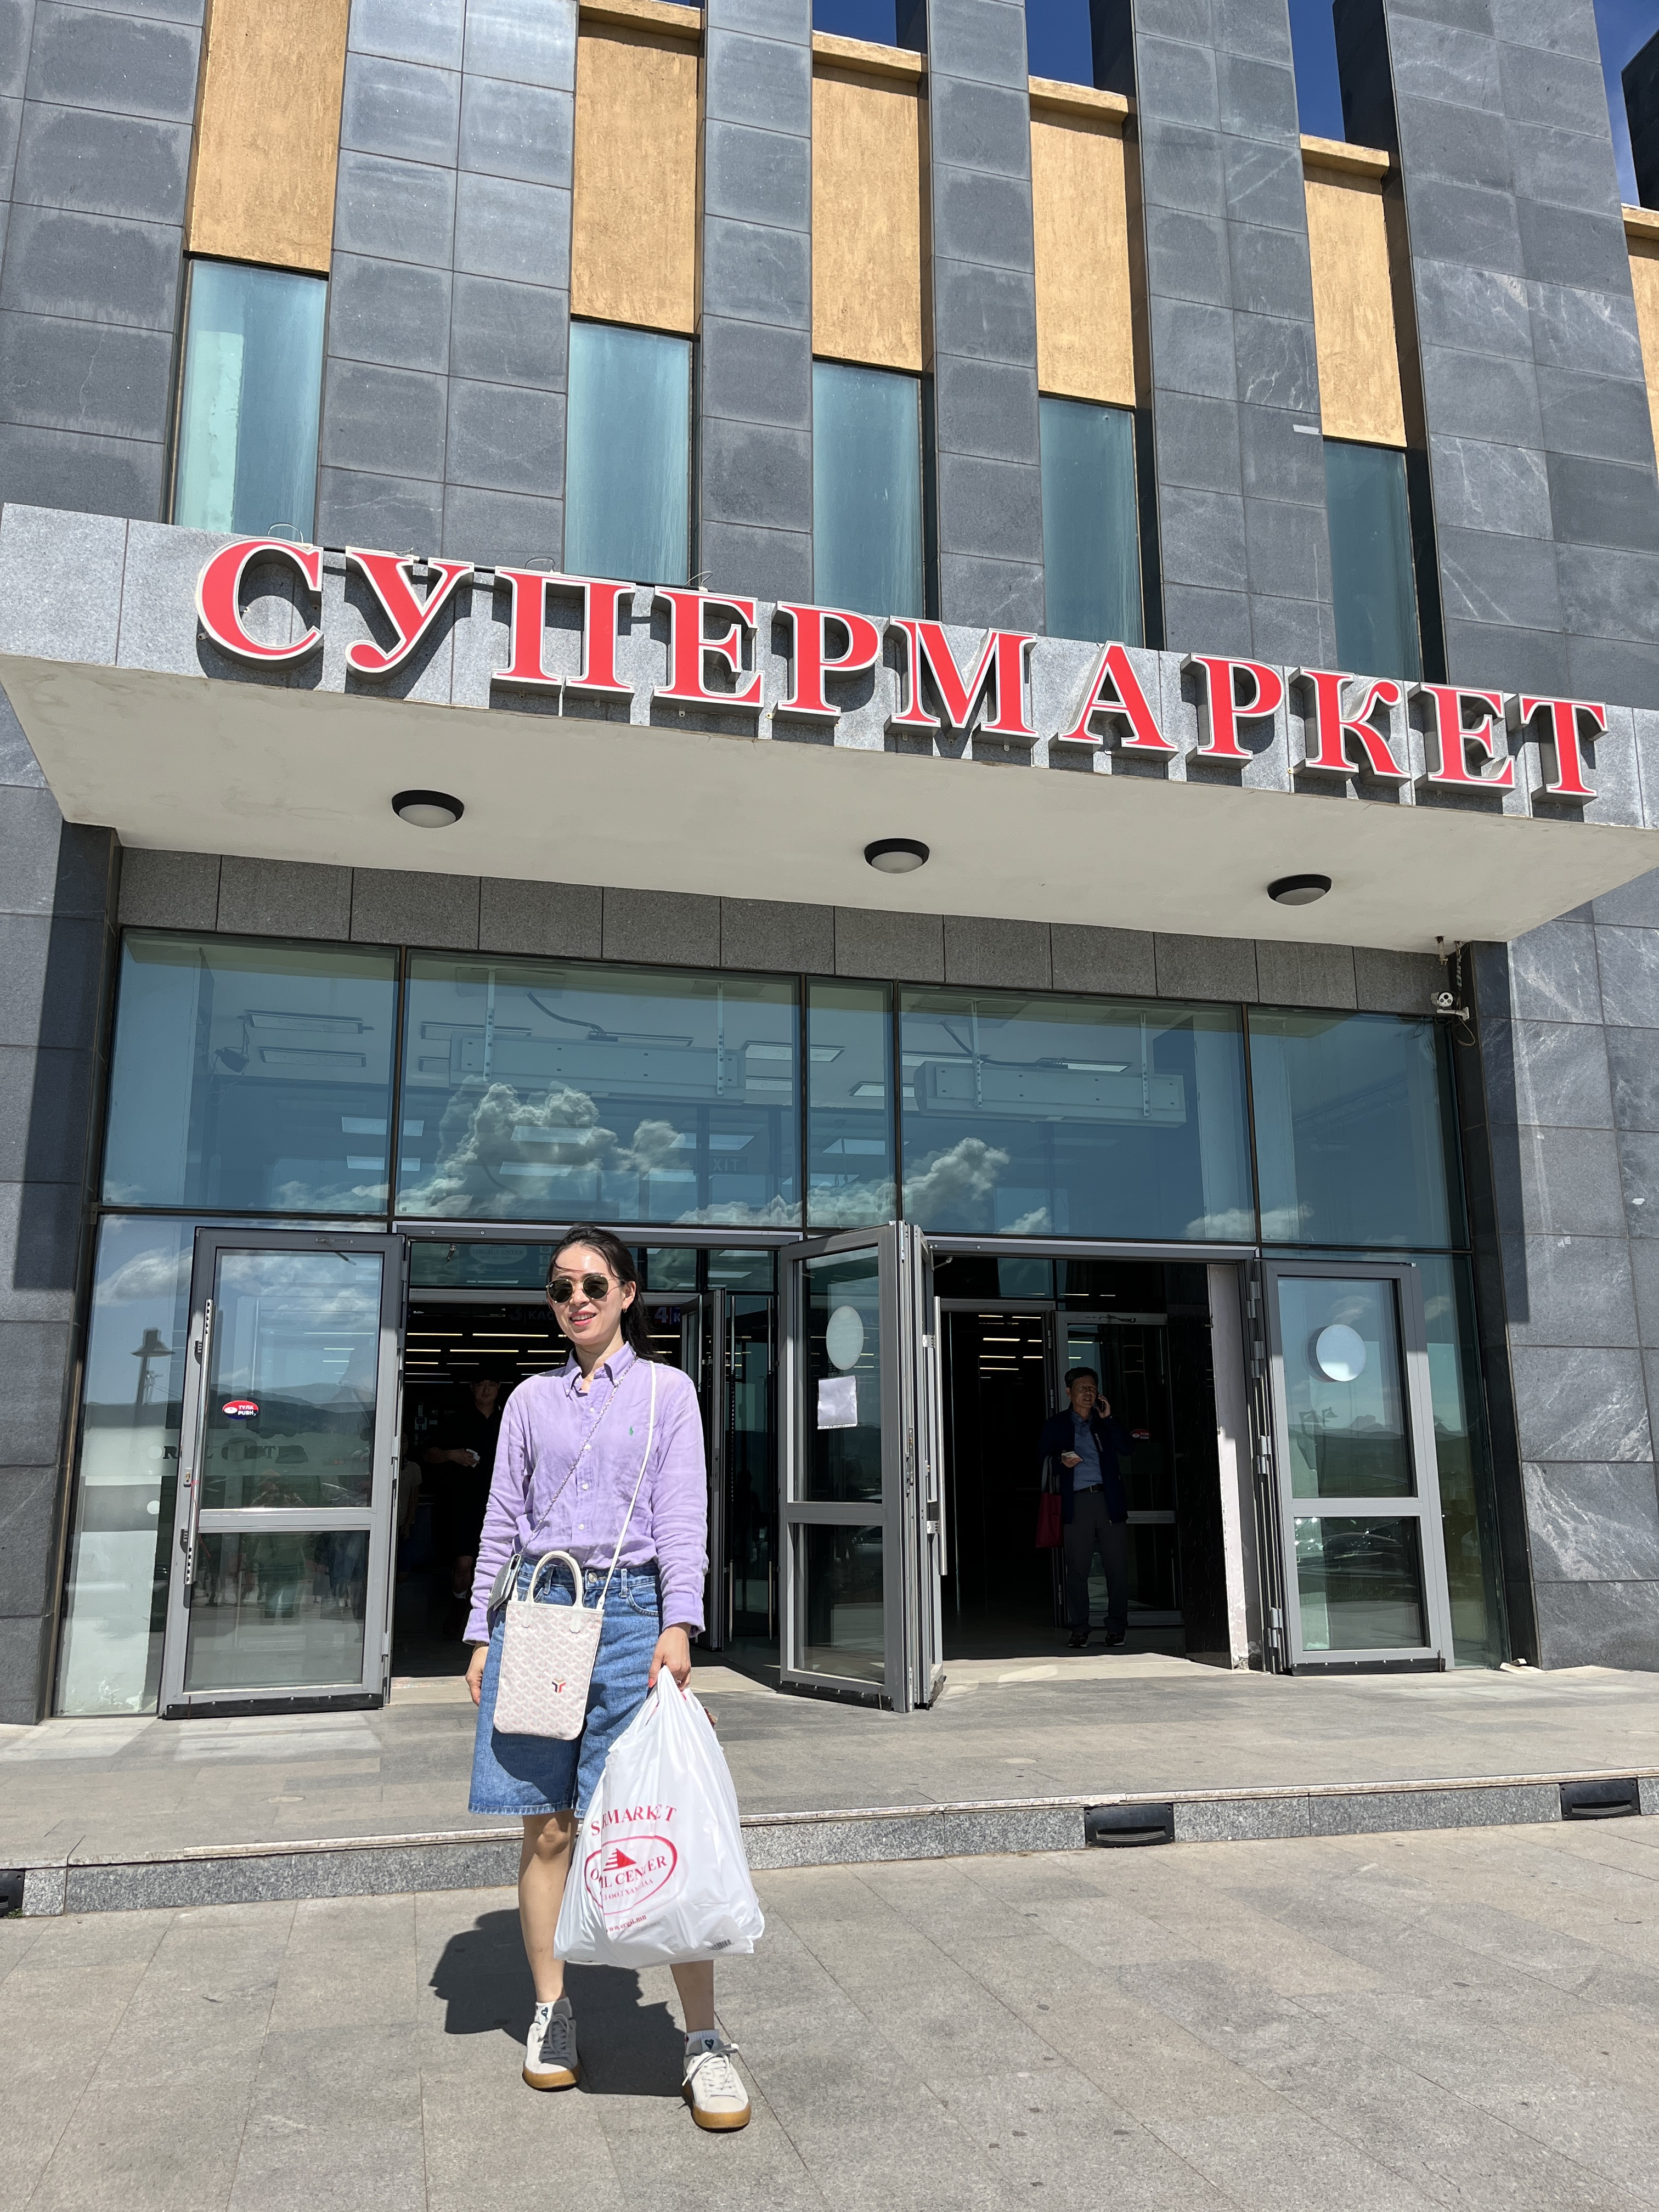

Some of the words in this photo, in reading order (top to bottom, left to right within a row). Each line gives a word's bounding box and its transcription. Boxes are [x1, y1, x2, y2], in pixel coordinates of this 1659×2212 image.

[195, 536, 1609, 798] СУПЕРМАРКЕТ
[709, 1158, 740, 1172] XIT
[654, 1306, 668, 1323] 4
[591, 1804, 676, 1836] SRMARKET
[590, 1868, 612, 1888] OIL
[615, 1855, 667, 1885] CENER
[606, 1915, 647, 1932] ww.orgil.mn
